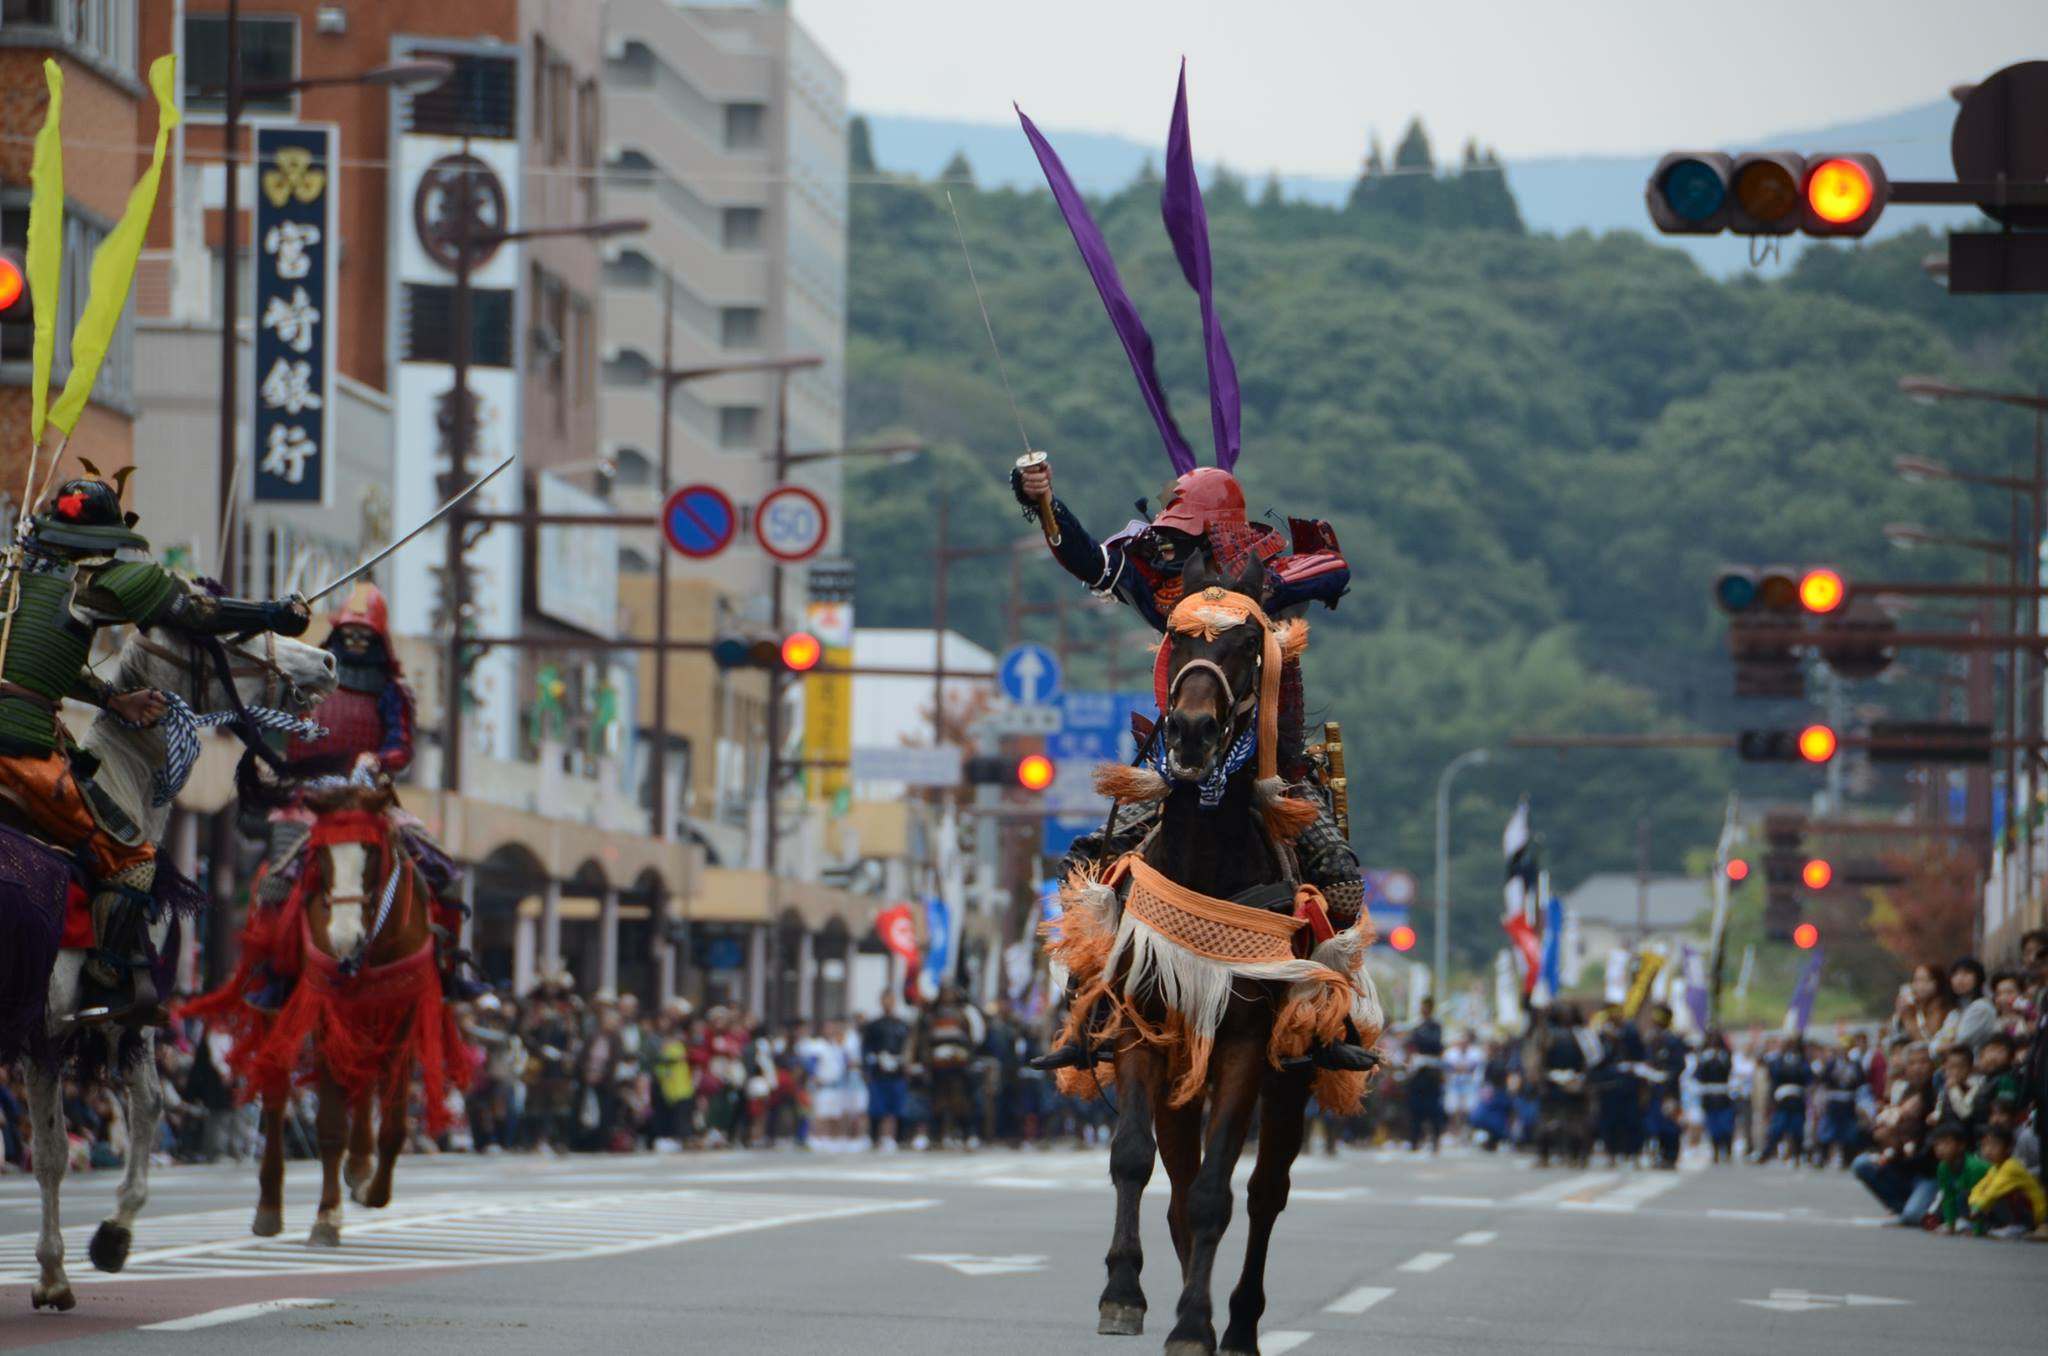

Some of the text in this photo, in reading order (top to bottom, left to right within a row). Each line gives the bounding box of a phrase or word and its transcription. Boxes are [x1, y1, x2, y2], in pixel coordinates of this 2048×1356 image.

[262, 219, 321, 484] 宮崎銀行
[770, 504, 814, 541] 50
